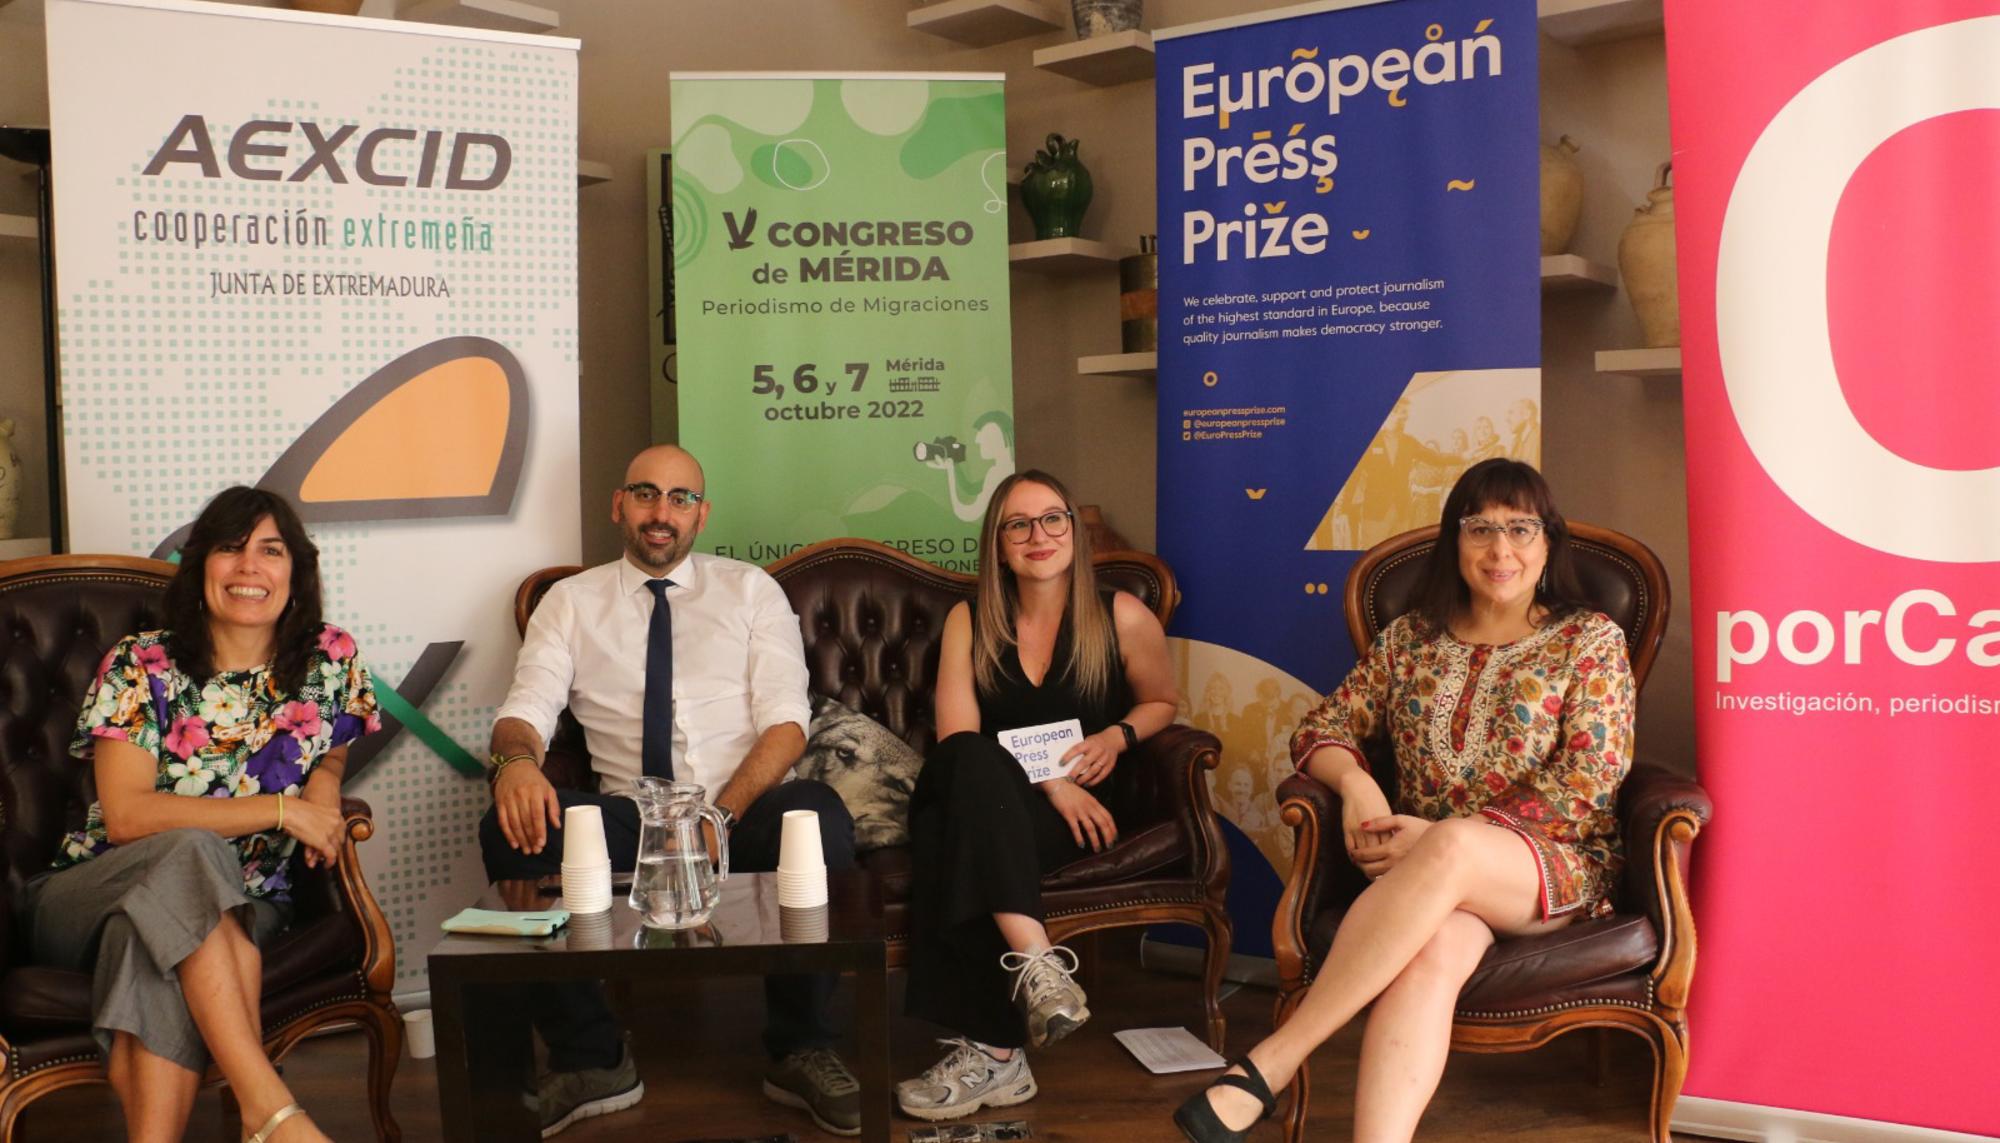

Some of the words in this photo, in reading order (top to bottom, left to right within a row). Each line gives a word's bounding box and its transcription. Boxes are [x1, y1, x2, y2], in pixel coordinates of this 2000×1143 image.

[141, 114, 512, 191] AEXCID
[134, 208, 328, 249] cooperación
[343, 213, 493, 252] extremeña
[767, 221, 974, 248] CONGRESO
[752, 262, 789, 285] de
[800, 250, 950, 283] MÉRIDA
[210, 272, 276, 298] JUNTA
[283, 276, 306, 295] DE
[312, 275, 451, 299] EXTREMADURA
[1184, 297, 1199, 308] We
[1202, 293, 1258, 307] celebrate,
[1262, 289, 1306, 303] support
[1310, 286, 1332, 299] and
[1336, 284, 1380, 298] protect
[1383, 279, 1444, 295] journalism
[702, 299, 822, 315] Periodismo
[830, 297, 856, 314] de
[863, 295, 990, 315] Migraciones
[1184, 315, 1195, 326] of
[1197, 313, 1215, 325] the
[1218, 310, 1259, 326] highest
[1263, 307, 1314, 321] standard
[1318, 305, 1328, 316] in
[1332, 303, 1376, 318] Europe,
[1379, 300, 1430, 313] because
[1183, 331, 1219, 346] quality
[1221, 328, 1279, 344] journalism
[1282, 325, 1317, 338] makes
[1321, 321, 1385, 337] democracy
[1389, 318, 1443, 334] stronger.
[886, 357, 945, 372] Mérida
[752, 364, 784, 399] 5,
[793, 363, 818, 394] 6
[825, 380, 837, 396] y
[845, 362, 869, 392] 7
[765, 401, 860, 420] octubre
[867, 400, 924, 418] 2022
[1183, 407, 1285, 418] europeanpressprize.com
[715, 545, 741, 560] EL
[749, 541, 814, 560] ÚNIC
[882, 538, 955, 555] RESO
[963, 538, 978, 553] D
[1717, 589, 2000, 683] porCa
[1717, 691, 1880, 715] Investigación,
[1011, 728, 1074, 749] European
[1015, 751, 1049, 764] Press
[1027, 767, 1051, 779] rize
